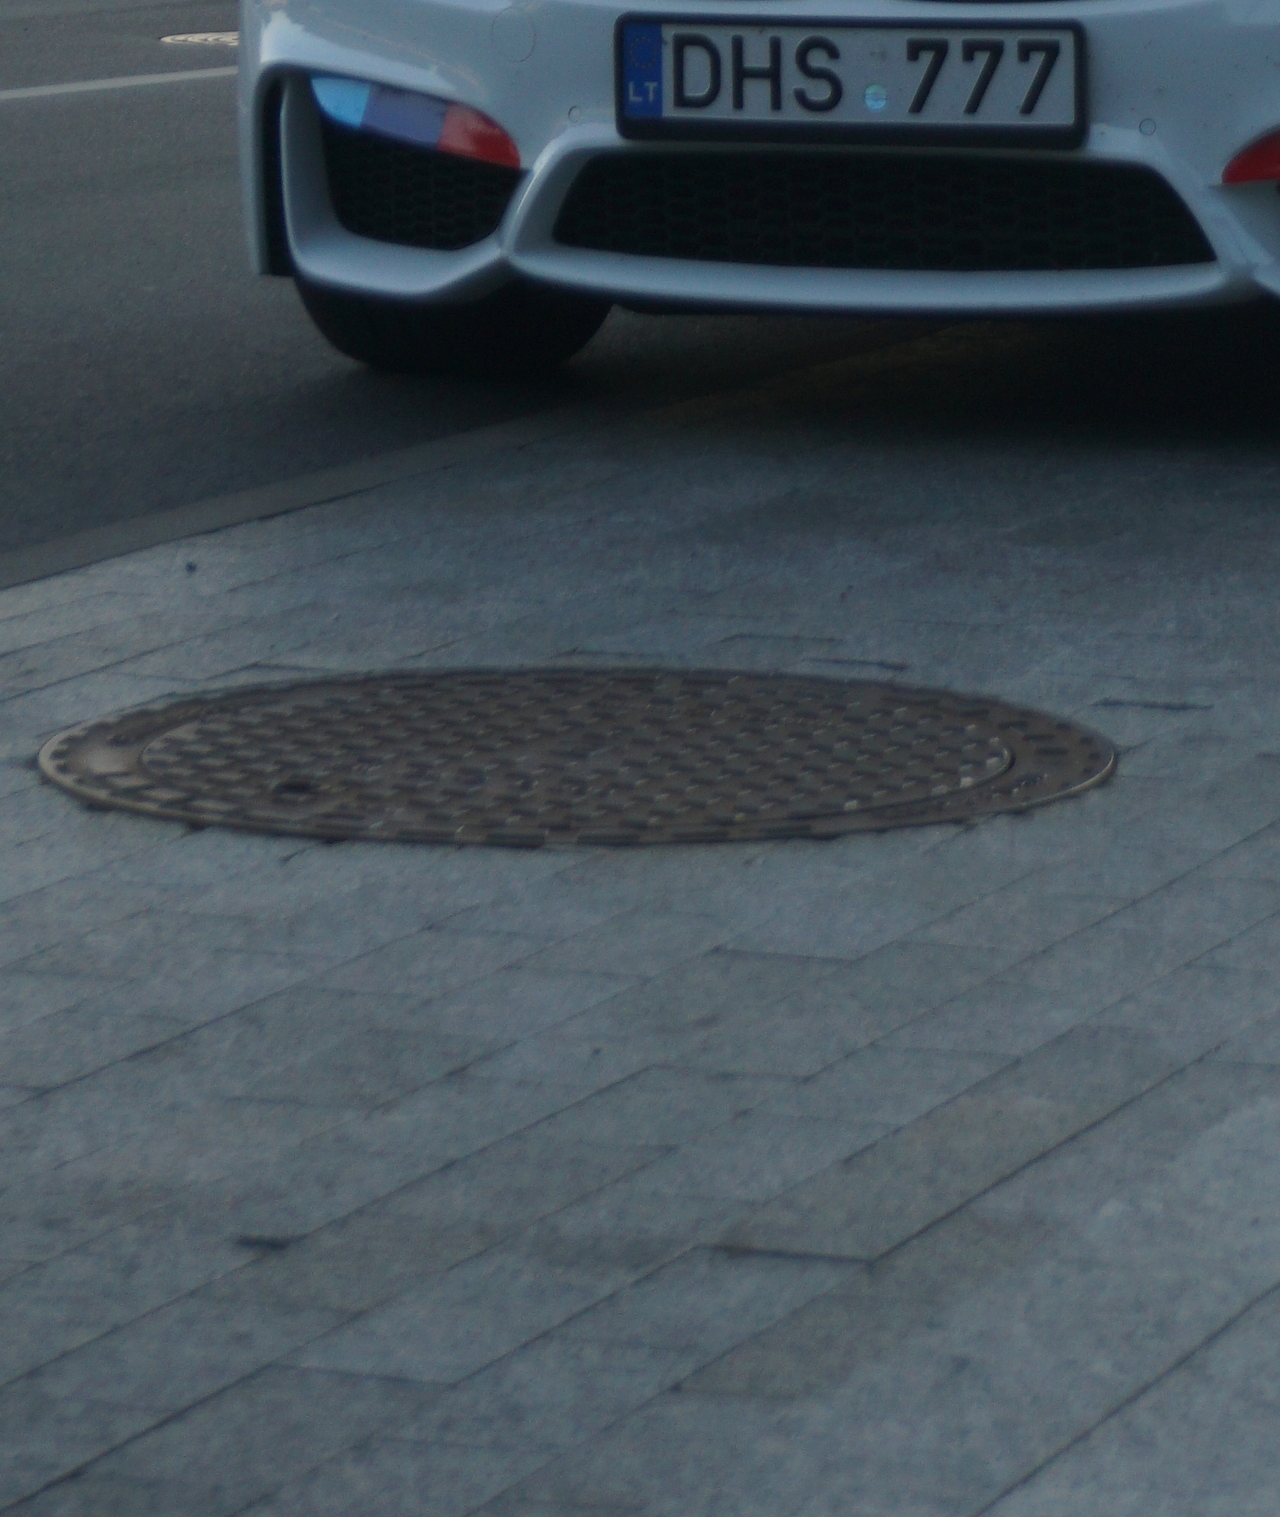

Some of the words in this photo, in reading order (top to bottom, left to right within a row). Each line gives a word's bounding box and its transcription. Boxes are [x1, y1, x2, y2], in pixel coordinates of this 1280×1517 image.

[629, 81, 658, 102] LT
[671, 32, 844, 113] DHS
[906, 37, 1061, 116] 777
